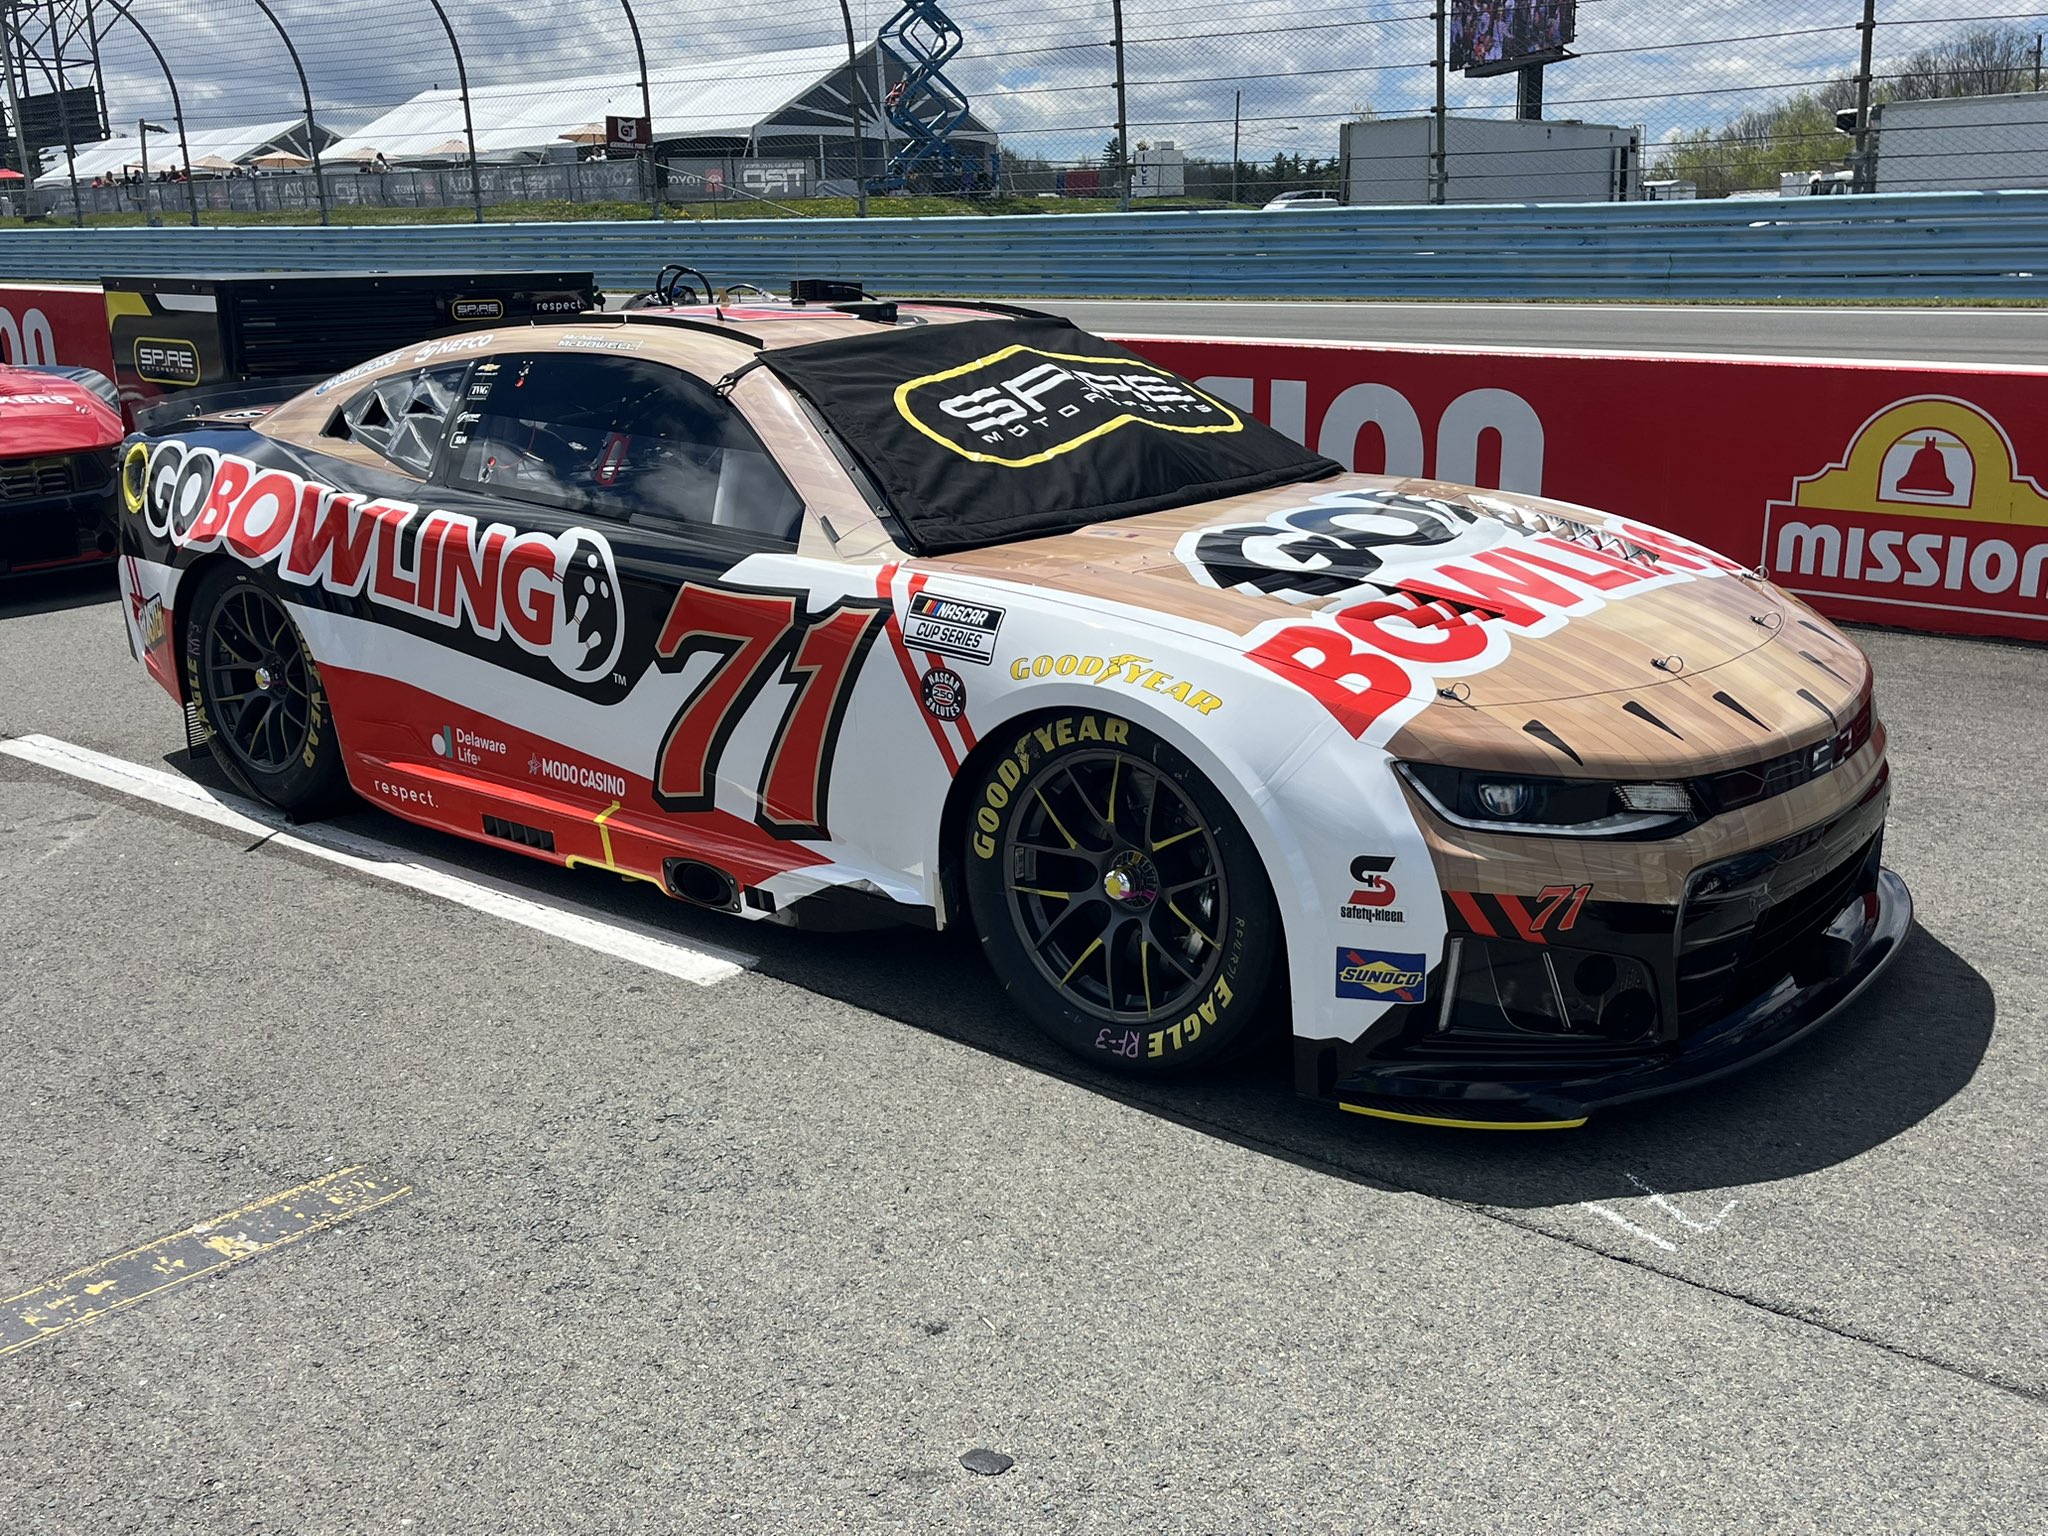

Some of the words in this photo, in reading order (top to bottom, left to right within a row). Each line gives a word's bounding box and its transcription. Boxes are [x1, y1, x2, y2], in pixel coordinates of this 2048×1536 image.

[435, 334, 494, 355] NEFCO
[140, 348, 193, 368] SPIRE
[1775, 522, 2048, 599] MISSION
[936, 602, 990, 626] NASCAR
[916, 622, 940, 639] CUP
[940, 627, 982, 648] SERIES
[927, 672, 960, 692] NASCAR
[933, 688, 954, 700] 250
[652, 581, 893, 841] 71
[926, 697, 960, 717] SALUTES
[456, 728, 506, 754] Delaware
[542, 757, 578, 784] MODO
[579, 767, 626, 797] CASINO
[374, 780, 439, 808] respect.
[1529, 884, 1593, 933] 71
[1342, 967, 1420, 986] SUNOCO
[1147, 974, 1235, 1059] EAGLE
